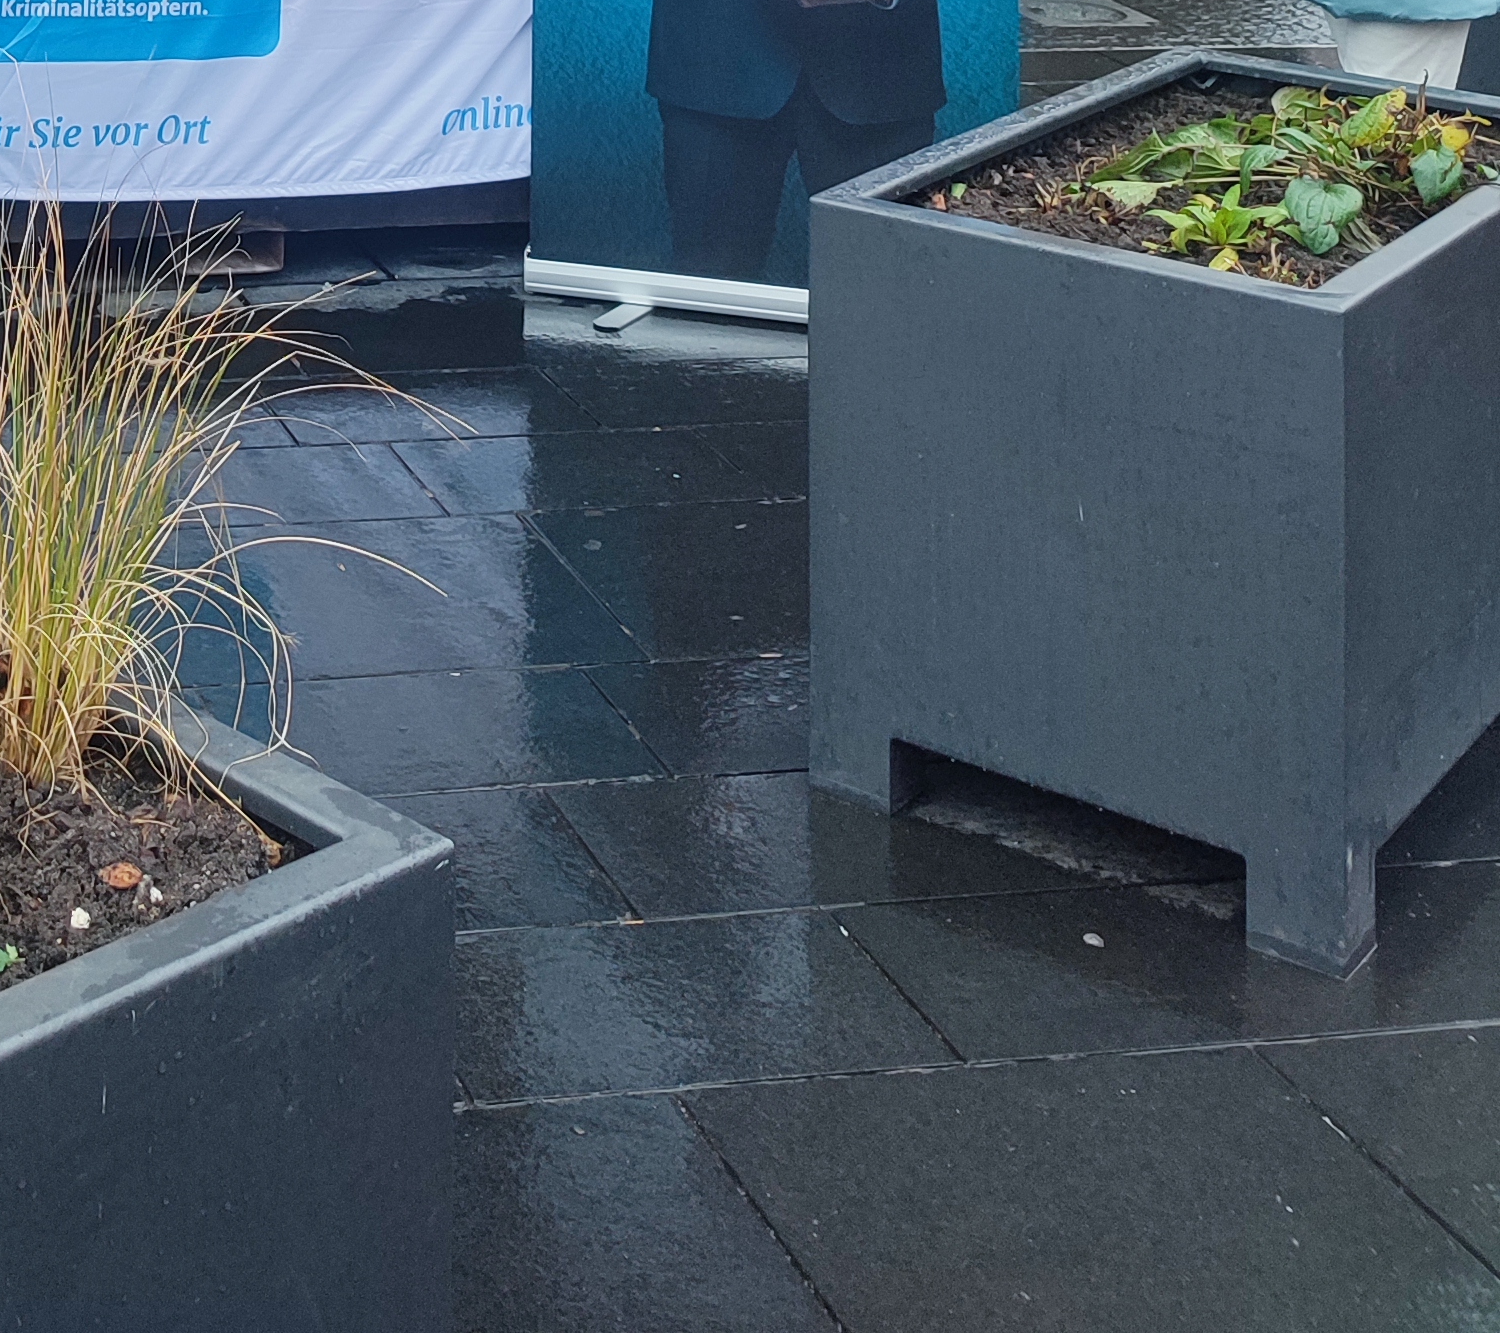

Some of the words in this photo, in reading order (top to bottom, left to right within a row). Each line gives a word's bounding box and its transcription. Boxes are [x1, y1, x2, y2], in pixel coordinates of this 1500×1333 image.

[30, 114, 81, 151] Sie
[92, 123, 149, 150] vor
[156, 113, 211, 146] Ort
